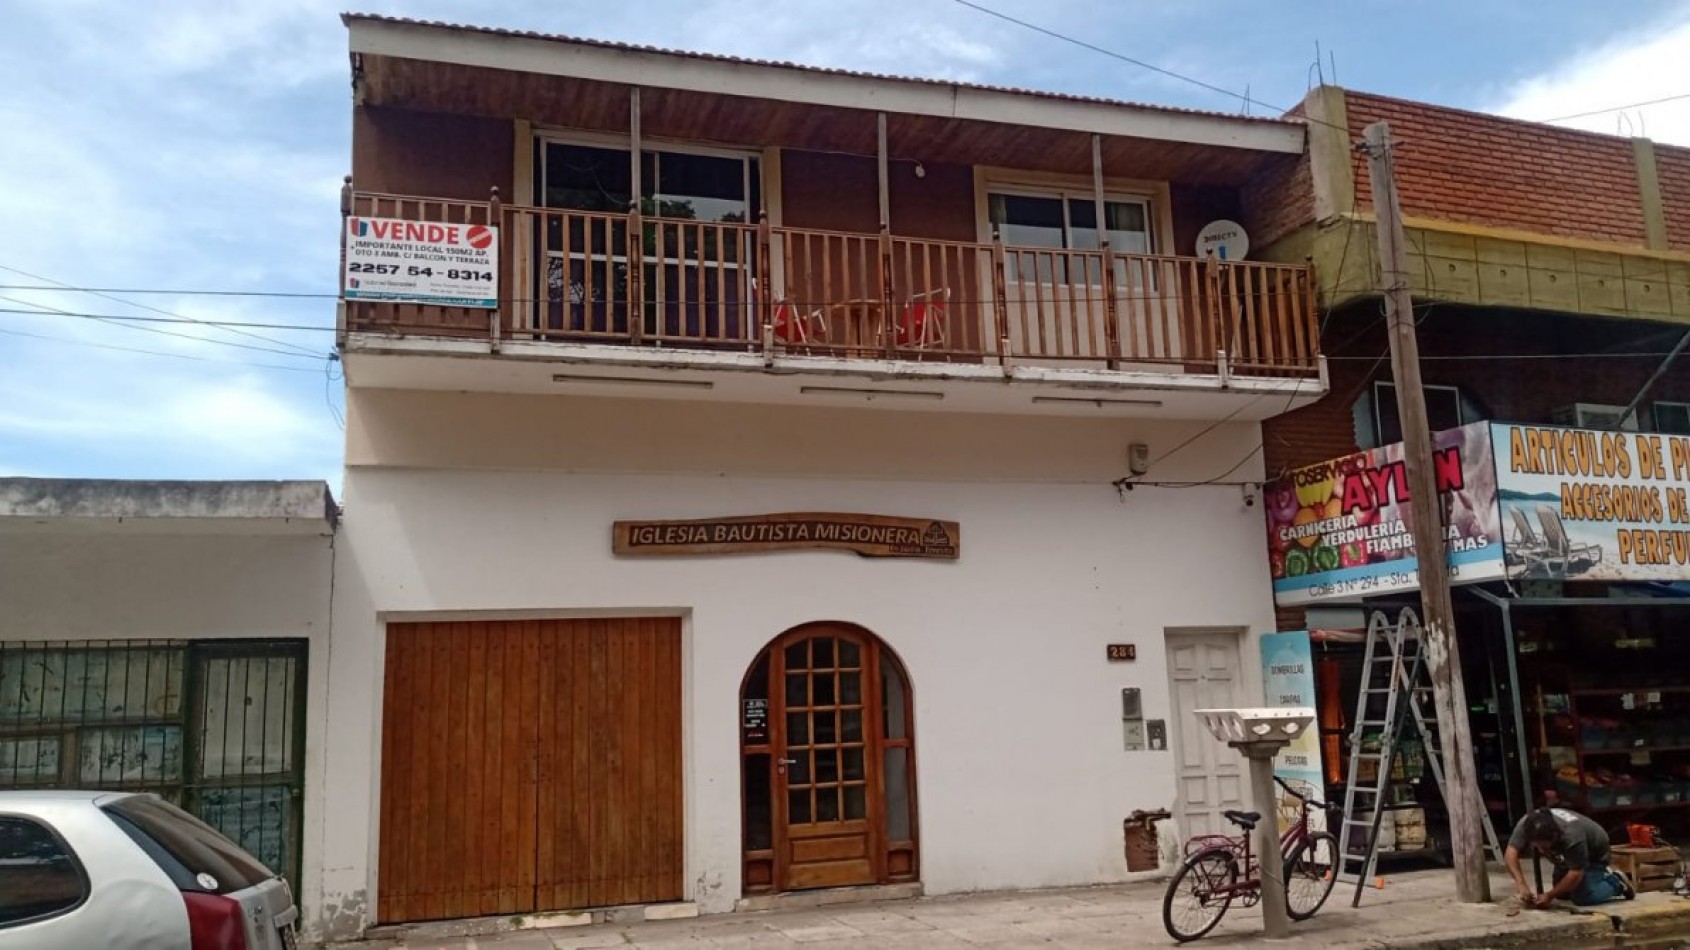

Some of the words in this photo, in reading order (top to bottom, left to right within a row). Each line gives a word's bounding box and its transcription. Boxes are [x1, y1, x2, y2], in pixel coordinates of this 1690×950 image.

[371, 220, 459, 245] VENDE
[355, 240, 412, 251] IMPORTANTE
[415, 245, 443, 253] LOCAL
[414, 252, 446, 262] BALCON
[456, 256, 490, 265] TERRAZA
[349, 262, 400, 275] 2257
[408, 266, 433, 278] 54
[447, 269, 493, 282] 8314
[1510, 426, 1632, 478] ARTICULOS
[1636, 434, 1667, 481] DE
[1341, 446, 1464, 514] AYLN
[1561, 482, 1664, 523] ACCESORIOS
[1666, 487, 1690, 524] DE
[632, 525, 708, 544] IGLESIA
[713, 523, 808, 542] BAUTISTA
[814, 522, 920, 544] MISIONERA
[1280, 514, 1357, 541] CARNICERIA
[1322, 519, 1407, 547] VERDULERIA
[1453, 534, 1488, 553] MAS
[1309, 582, 1334, 597] Calle
[1360, 575, 1379, 590] 294
[1390, 572, 1413, 586] Sta.
